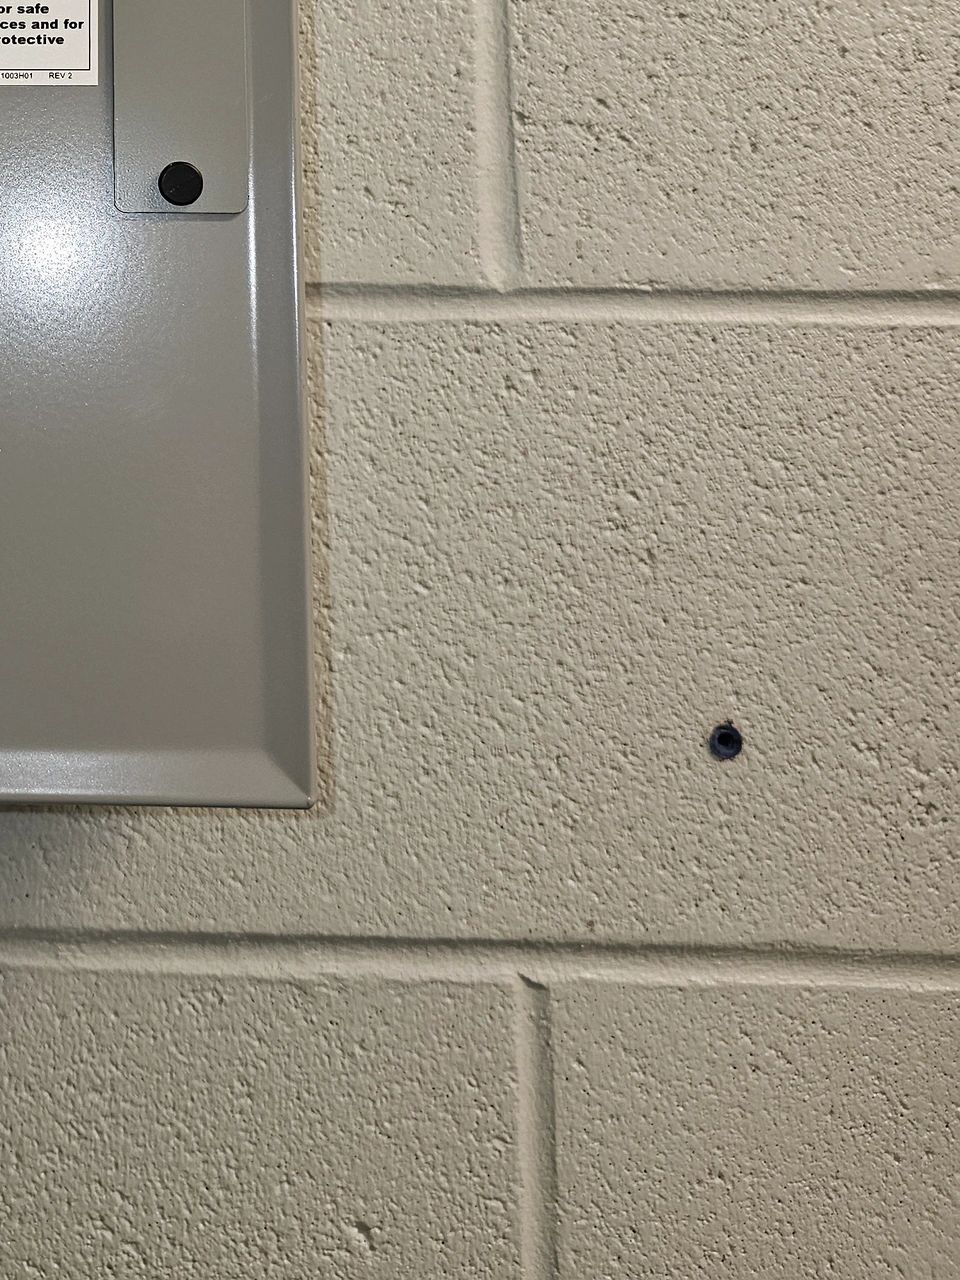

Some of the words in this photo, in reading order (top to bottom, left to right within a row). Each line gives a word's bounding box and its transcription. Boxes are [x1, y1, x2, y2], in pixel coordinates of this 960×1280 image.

[17, 3, 49, 14] safe
[31, 19, 58, 29] and
[63, 18, 84, 29] for
